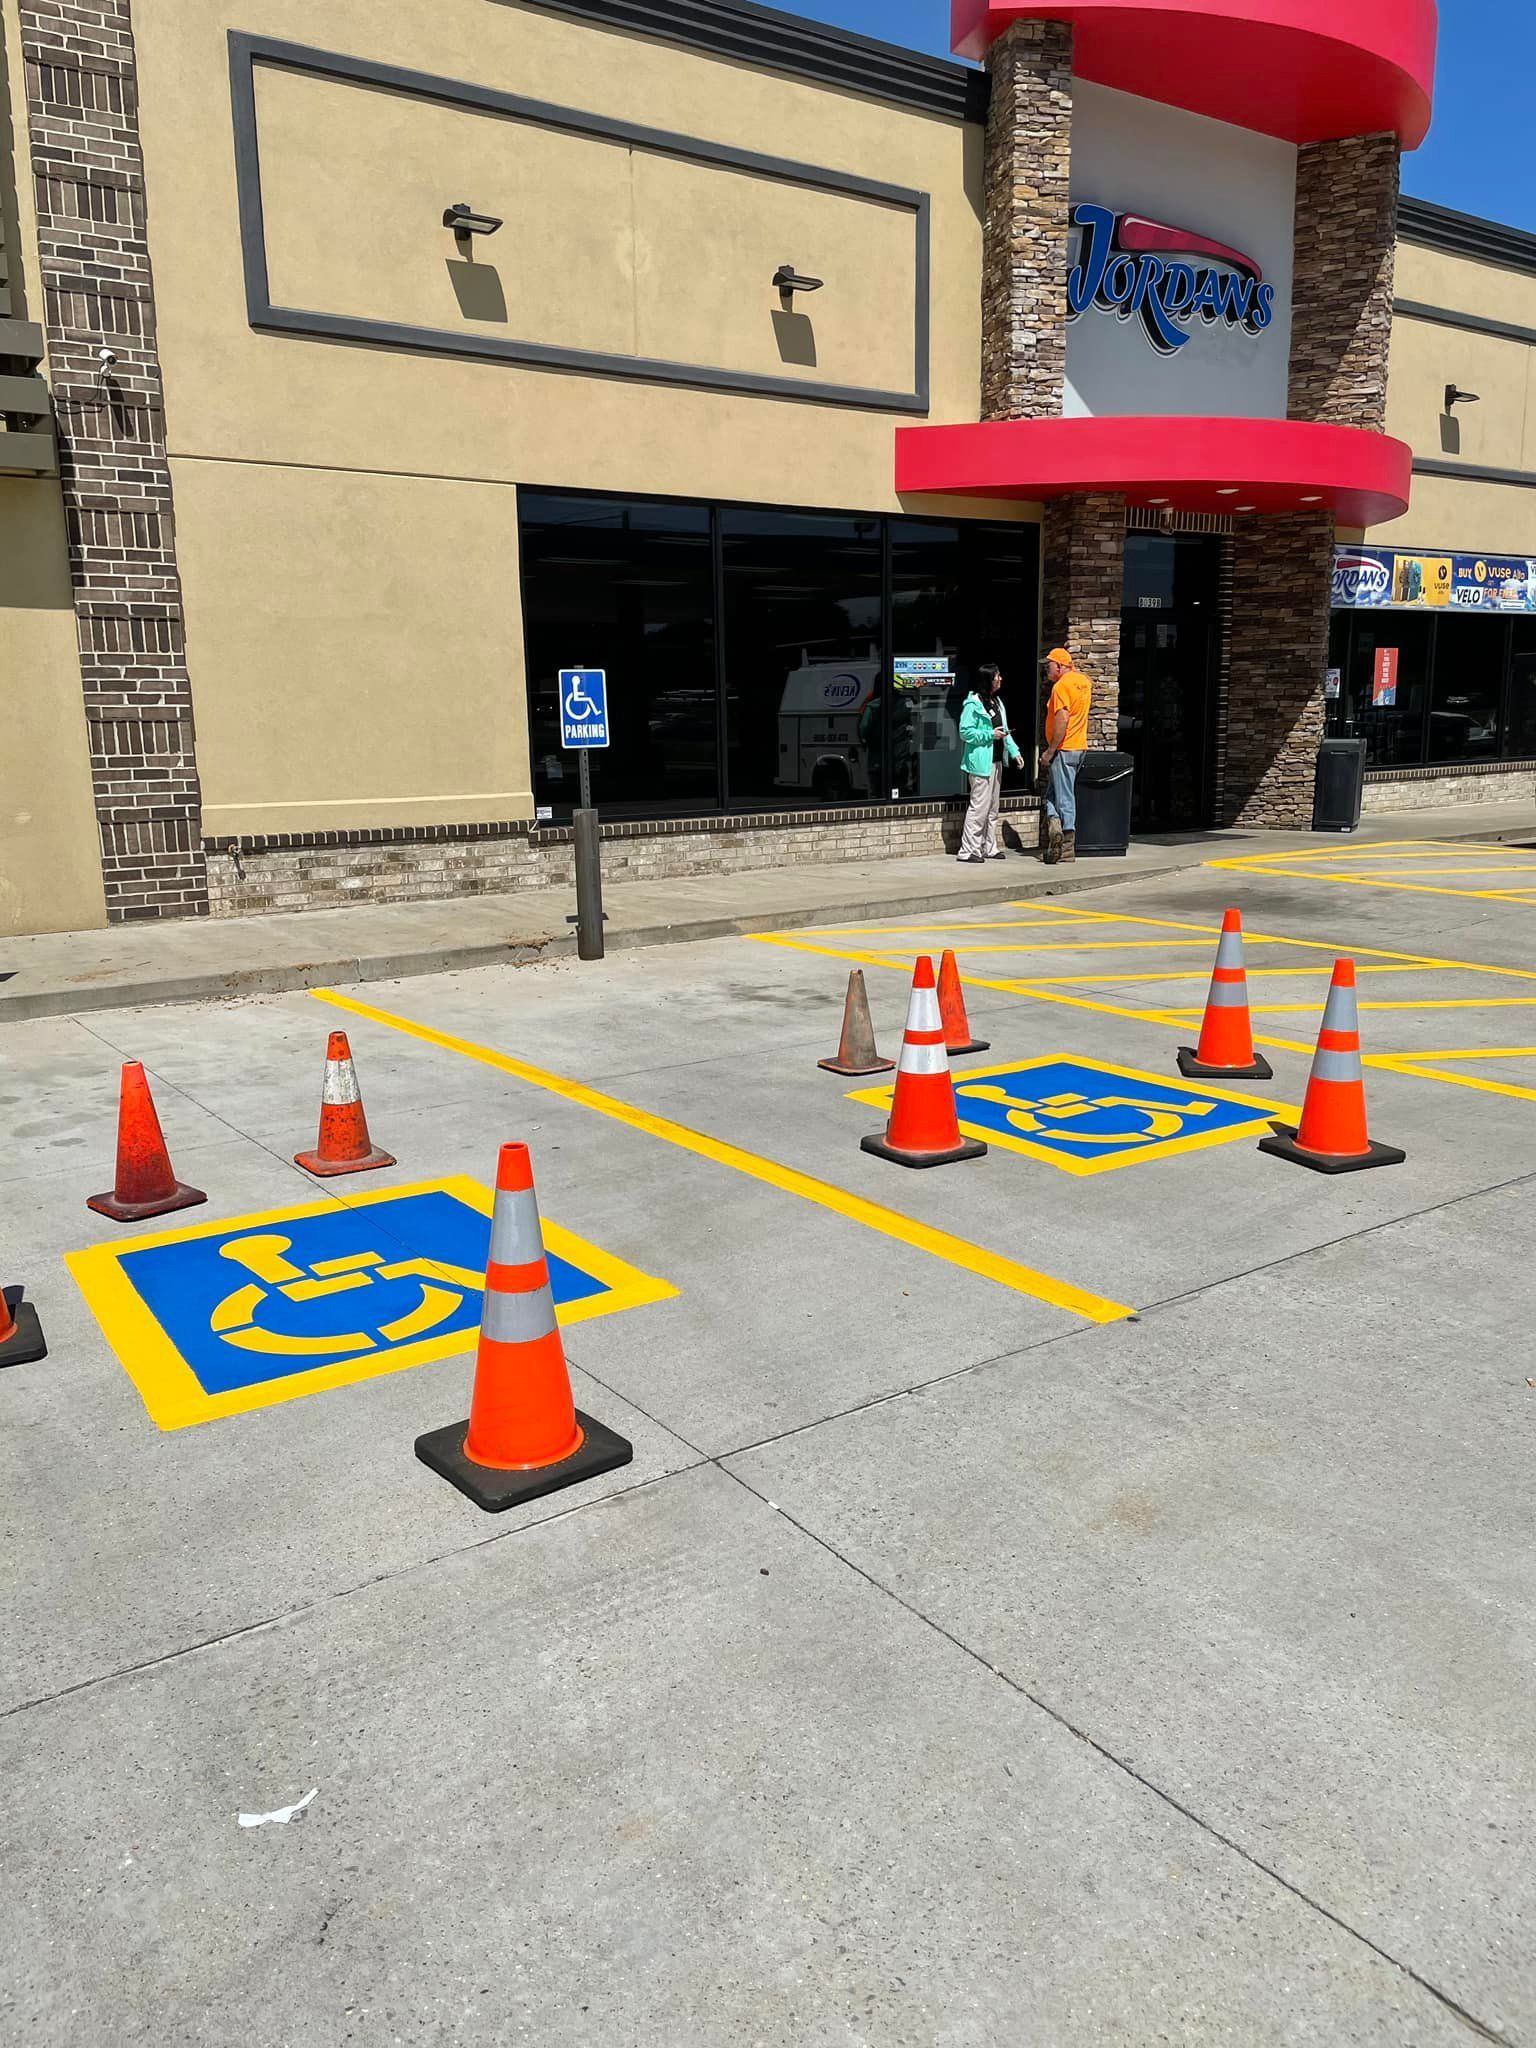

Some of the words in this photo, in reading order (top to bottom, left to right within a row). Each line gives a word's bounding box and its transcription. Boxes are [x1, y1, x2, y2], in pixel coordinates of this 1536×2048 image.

[1068, 203, 1275, 347] JORDANS
[1458, 567, 1472, 578] BUY
[1332, 568, 1387, 598] ORDANS
[1457, 588, 1481, 604] VELO
[565, 723, 605, 739] PARKING
